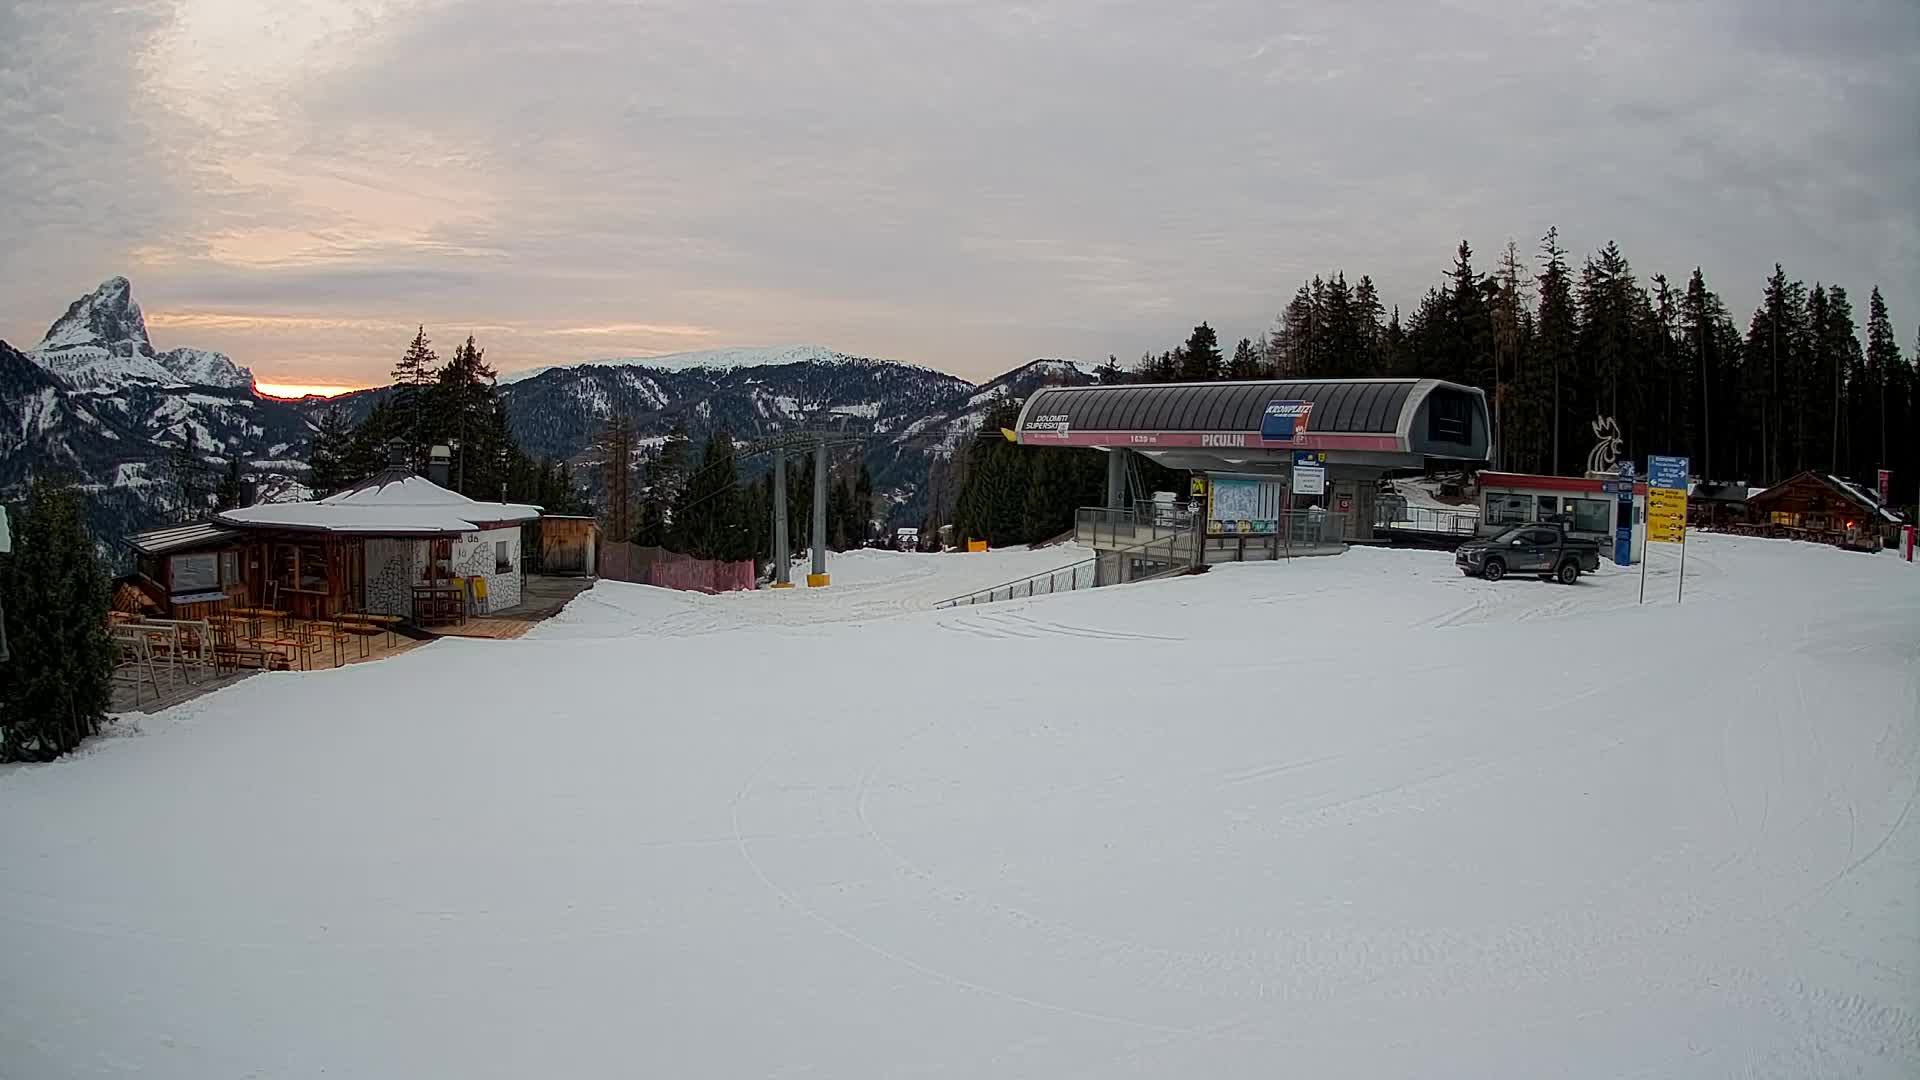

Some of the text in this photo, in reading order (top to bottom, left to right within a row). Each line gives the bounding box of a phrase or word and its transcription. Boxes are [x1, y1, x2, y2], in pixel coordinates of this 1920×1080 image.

[1265, 405, 1310, 413] KRONPLATZ
[1025, 422, 1058, 430] SUPERSKI
[1201, 434, 1245, 447] PICULIN
